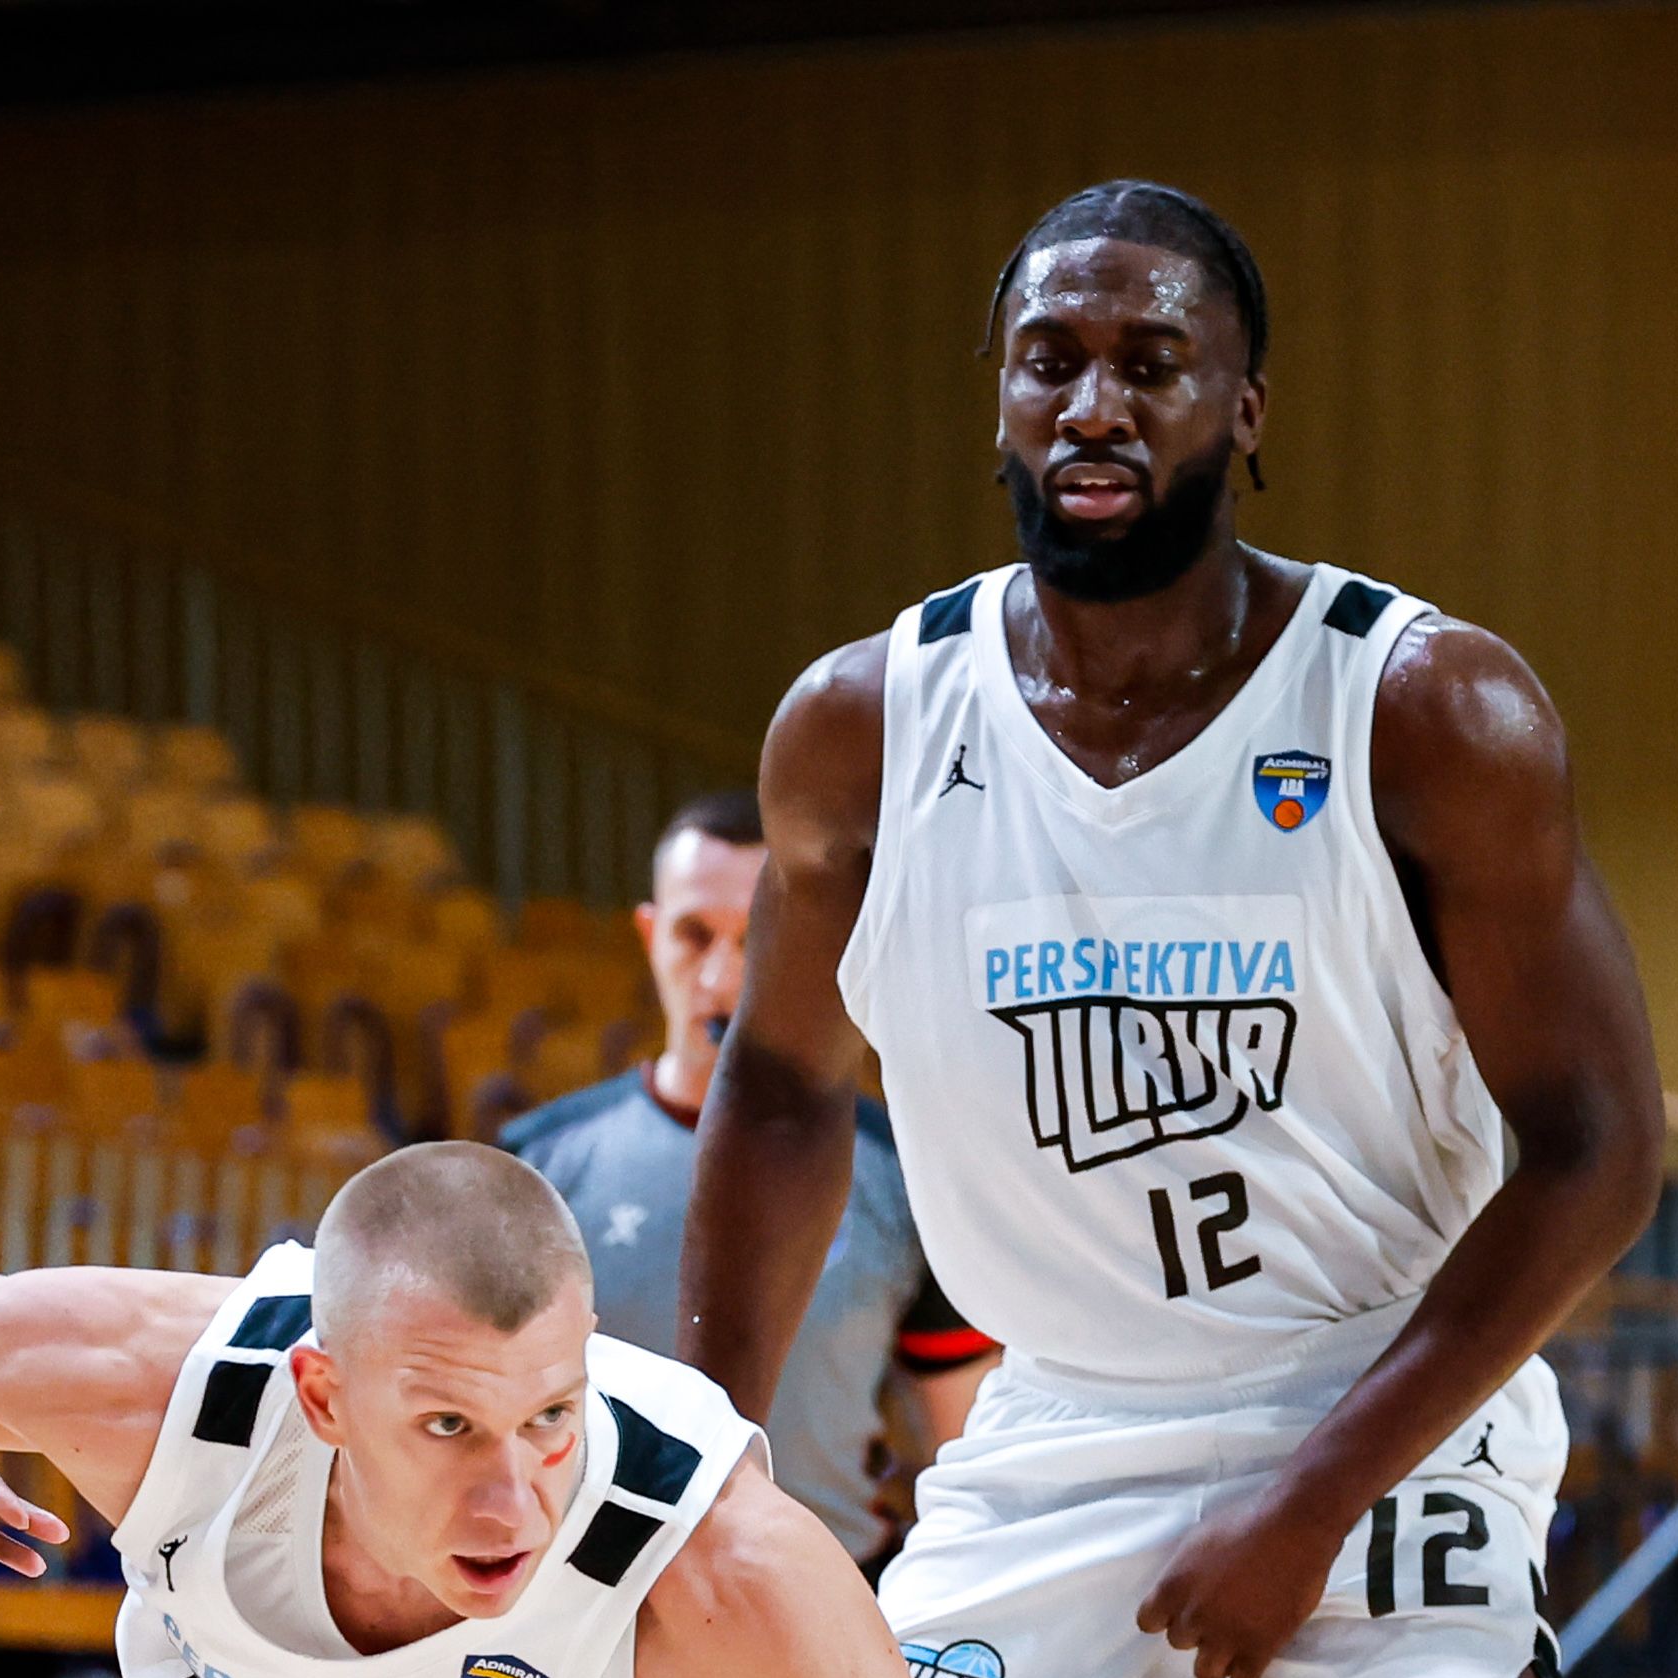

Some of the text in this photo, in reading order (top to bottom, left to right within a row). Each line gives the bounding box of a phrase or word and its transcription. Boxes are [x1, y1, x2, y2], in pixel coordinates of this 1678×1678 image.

[985, 938, 1296, 1001] PERSPEKTIVA
[1147, 1171, 1262, 1300] 12
[1366, 1492, 1491, 1618] 12
